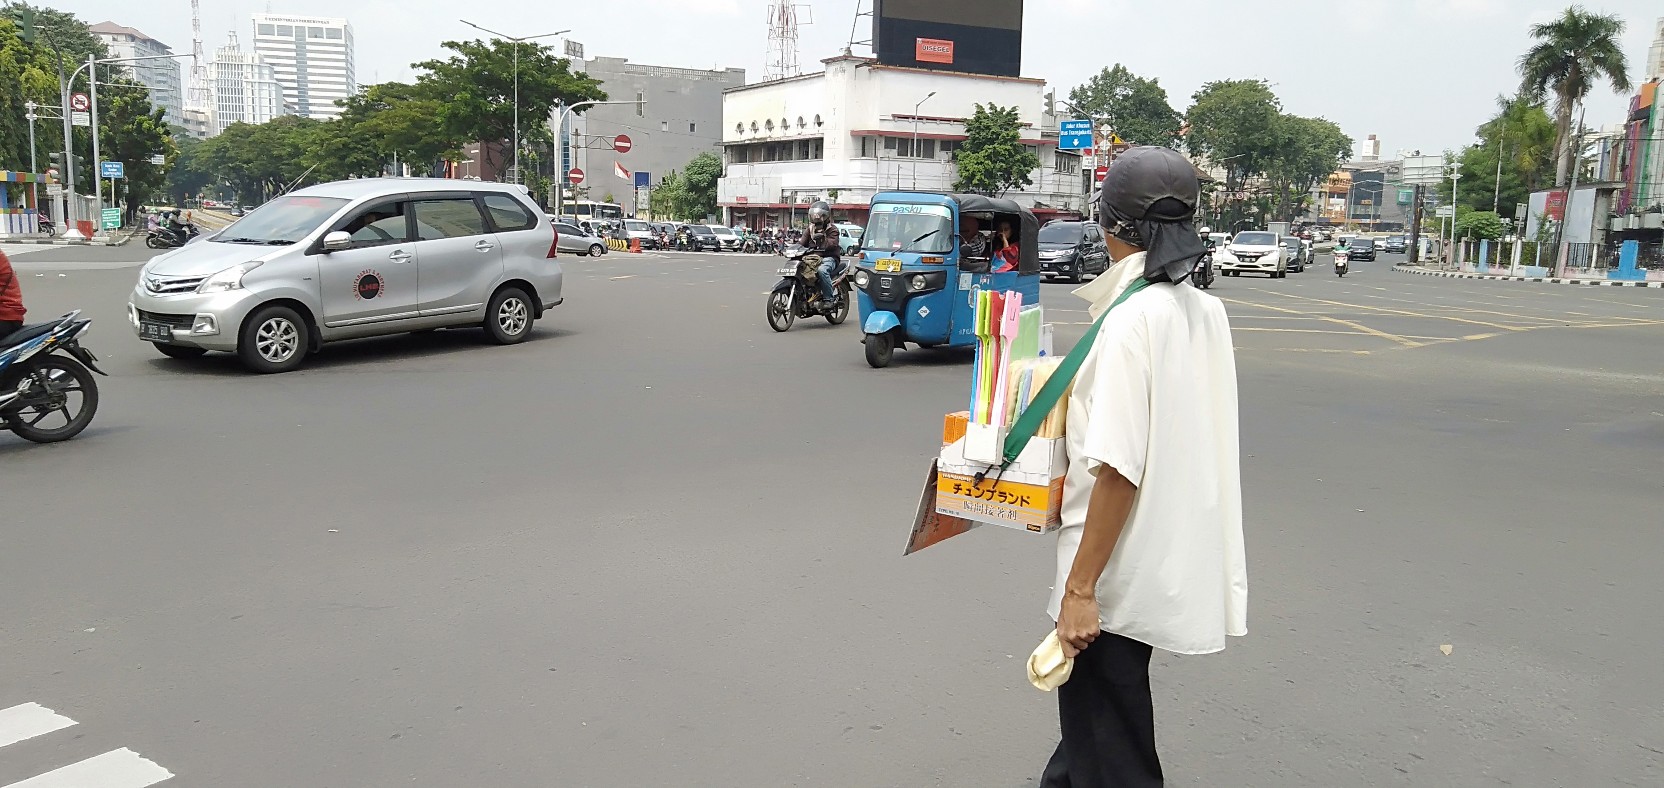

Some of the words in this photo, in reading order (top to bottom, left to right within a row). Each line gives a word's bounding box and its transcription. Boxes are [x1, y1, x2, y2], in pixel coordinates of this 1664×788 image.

[922, 45, 950, 53] DISEGEL
[953, 483, 1030, 507] チュンブランド
